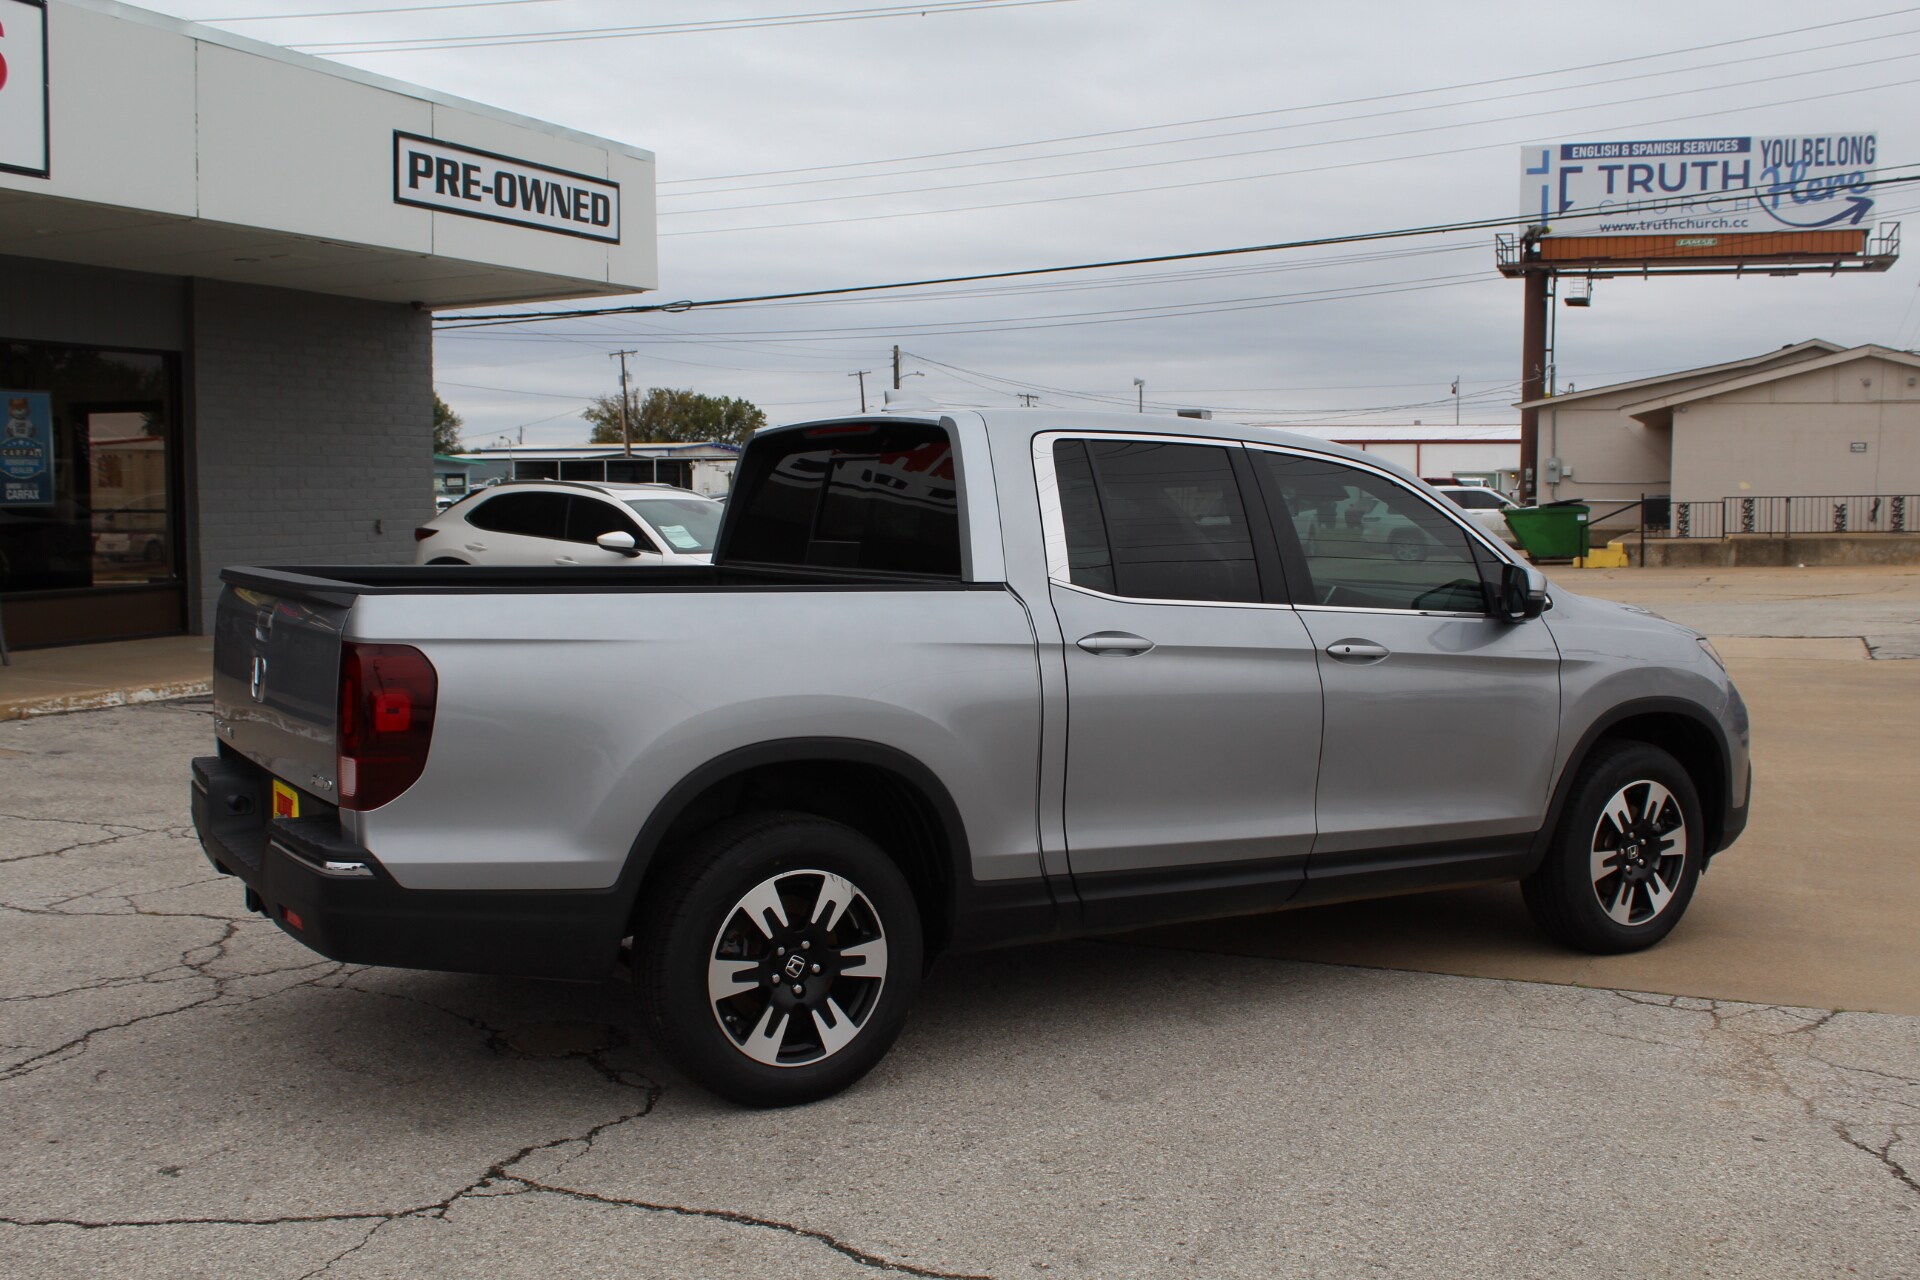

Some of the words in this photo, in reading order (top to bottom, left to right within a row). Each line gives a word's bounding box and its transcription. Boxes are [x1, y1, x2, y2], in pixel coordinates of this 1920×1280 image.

[1571, 144, 1619, 159] ENGLISH
[1621, 143, 1630, 156] &
[1632, 141, 1681, 156] SPANISH
[1683, 139, 1739, 154] SERVICES
[1760, 138, 1796, 169] YOU
[1802, 134, 1876, 168] BELONG
[408, 150, 611, 228] PRE-OWNED
[1598, 160, 1751, 195] TRUTH
[1760, 160, 1873, 210] Here
[1599, 195, 1750, 216] CHURCH
[1599, 217, 1749, 232] www.truthchurch.cc
[6, 489, 40, 500] CARFAX
